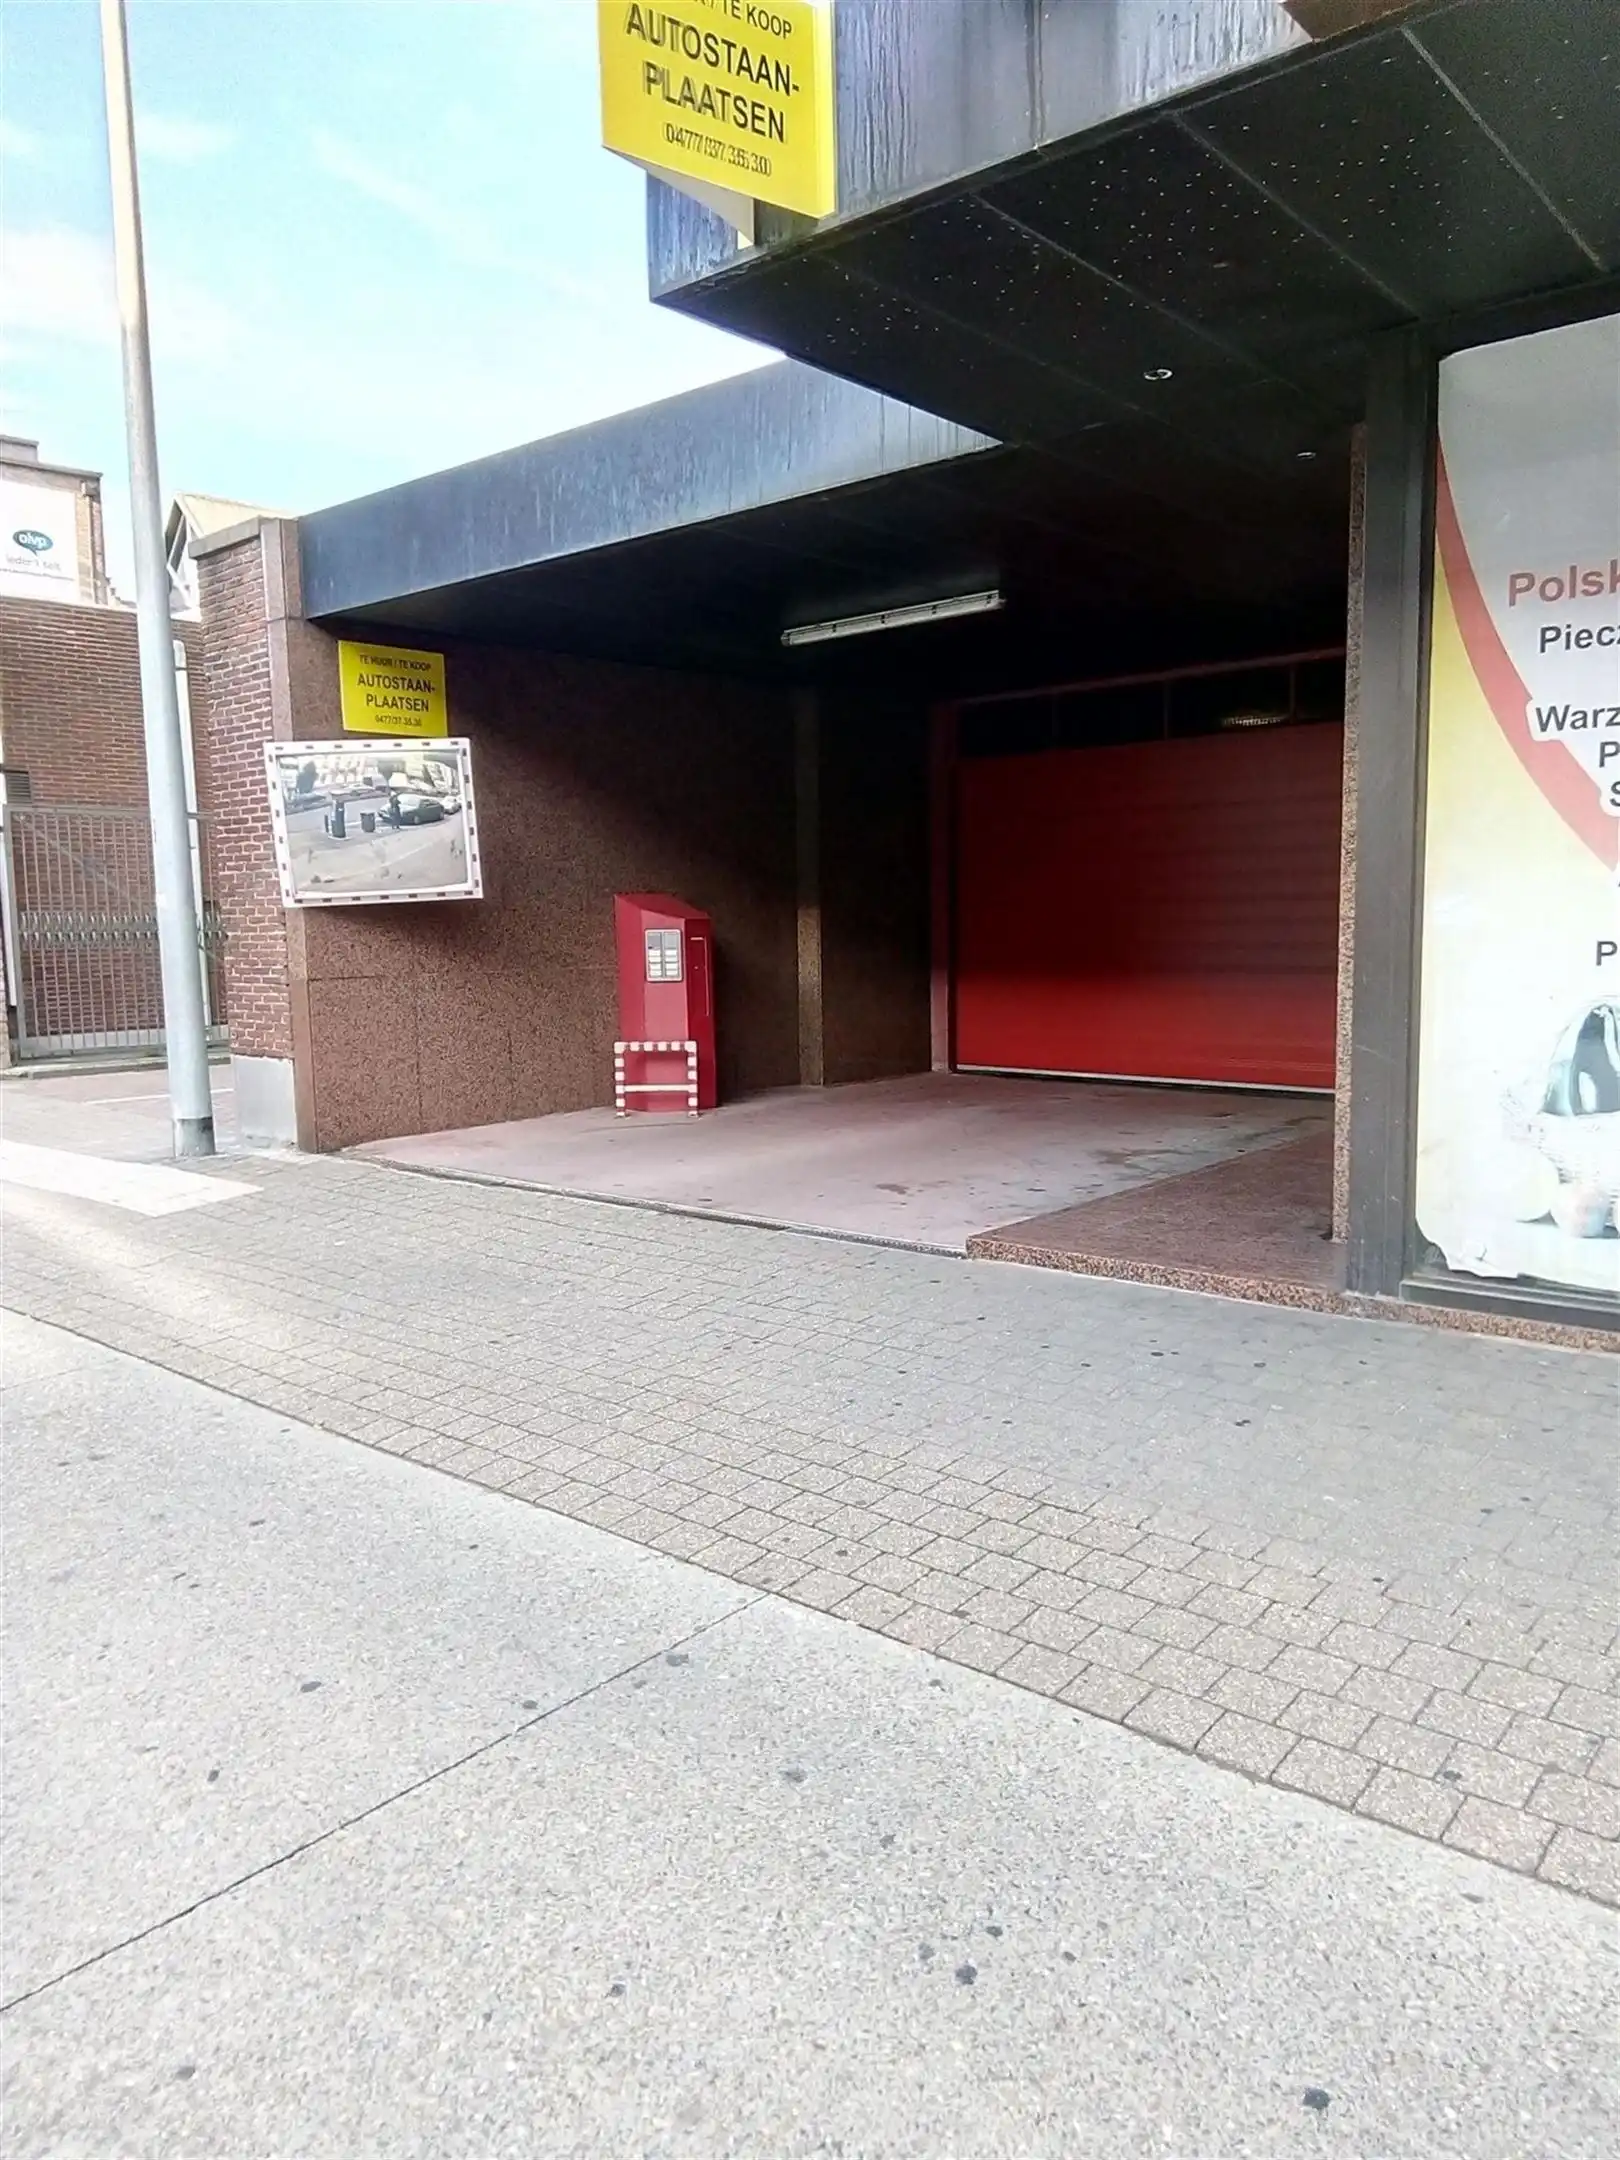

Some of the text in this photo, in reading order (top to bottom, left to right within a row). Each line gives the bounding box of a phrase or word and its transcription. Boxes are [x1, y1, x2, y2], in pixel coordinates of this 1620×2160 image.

[746, 3, 793, 40] KOOP
[626, 3, 800, 97] AUTOSTAAN-
[642, 61, 785, 143] PLAATSEN
[1540, 623, 1620, 653] Piec
[357, 673, 436, 693] AUTOSTAAN-
[366, 693, 429, 712] PLAATSEN
